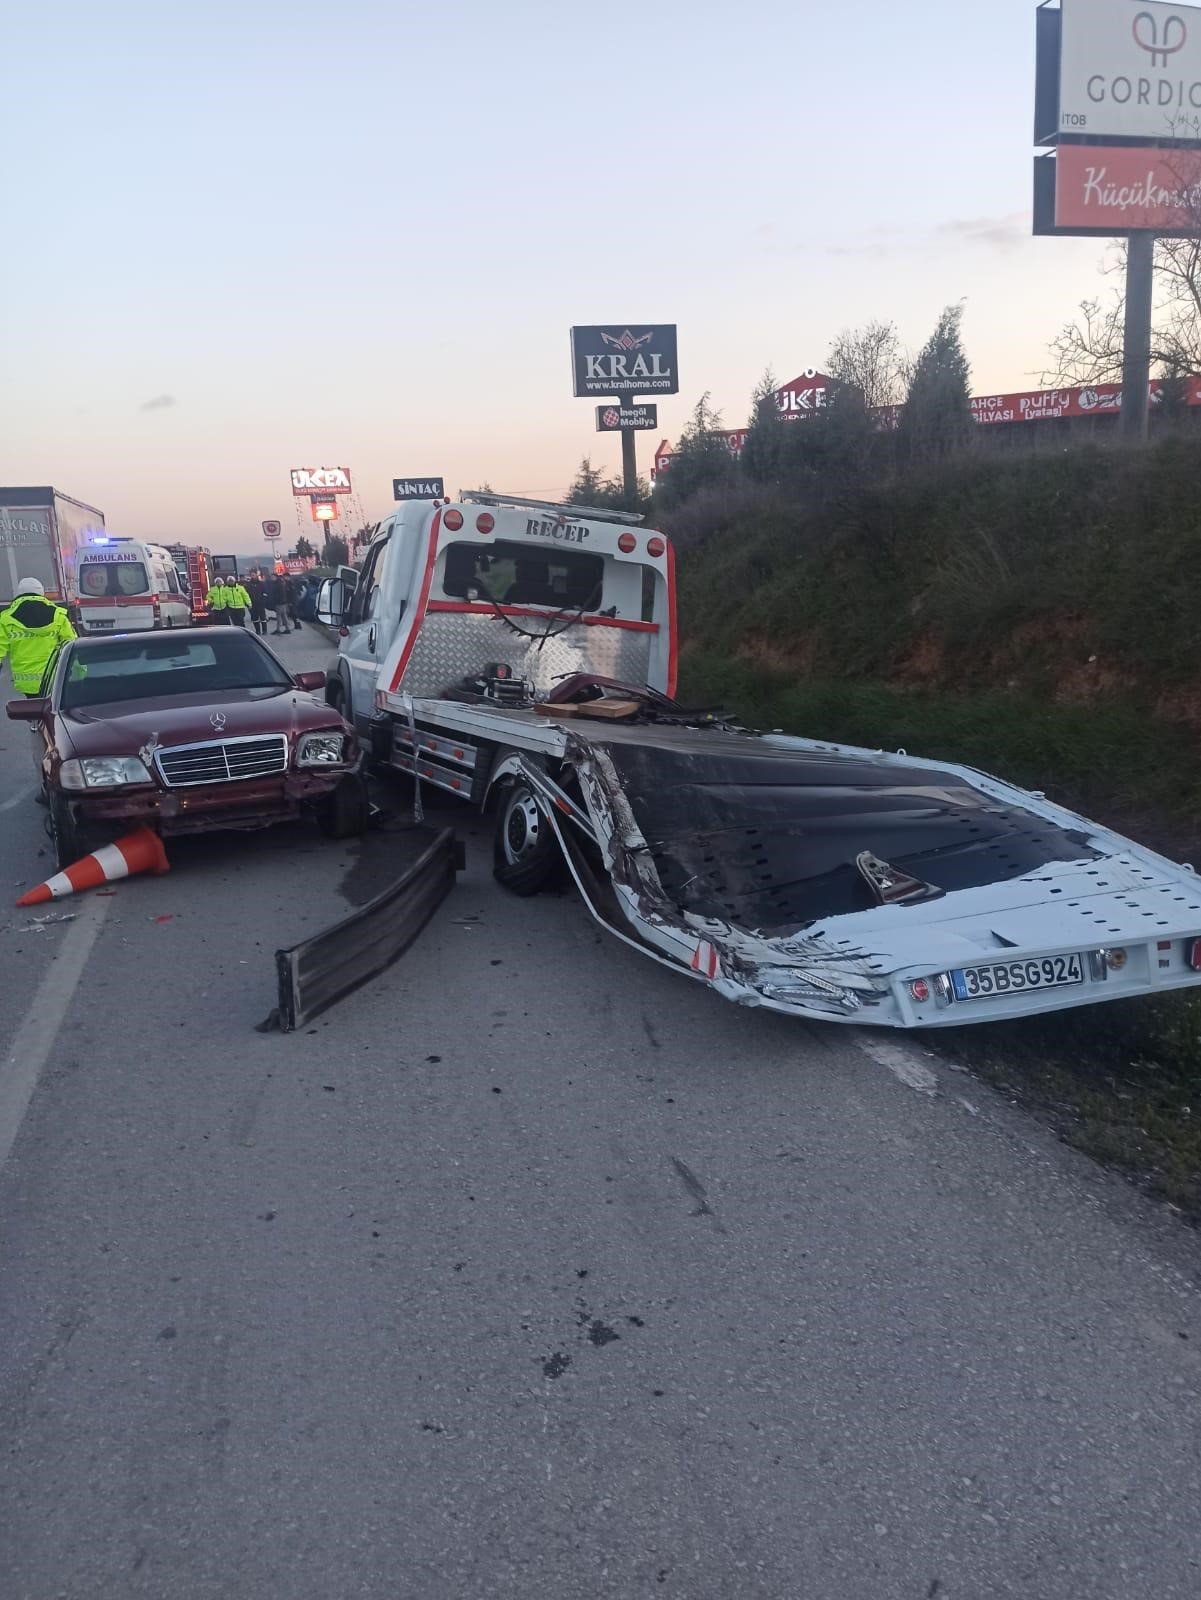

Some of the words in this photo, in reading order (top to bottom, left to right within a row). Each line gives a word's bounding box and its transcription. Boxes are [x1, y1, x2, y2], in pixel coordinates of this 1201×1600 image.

[584, 353, 671, 379] KRAL
[586, 379, 671, 390] www.kralhome.com
[1020, 391, 1070, 413] puffy
[620, 417, 655, 427] Mobilya
[526, 519, 590, 544] RECEP
[83, 553, 138, 563] AMBULANS
